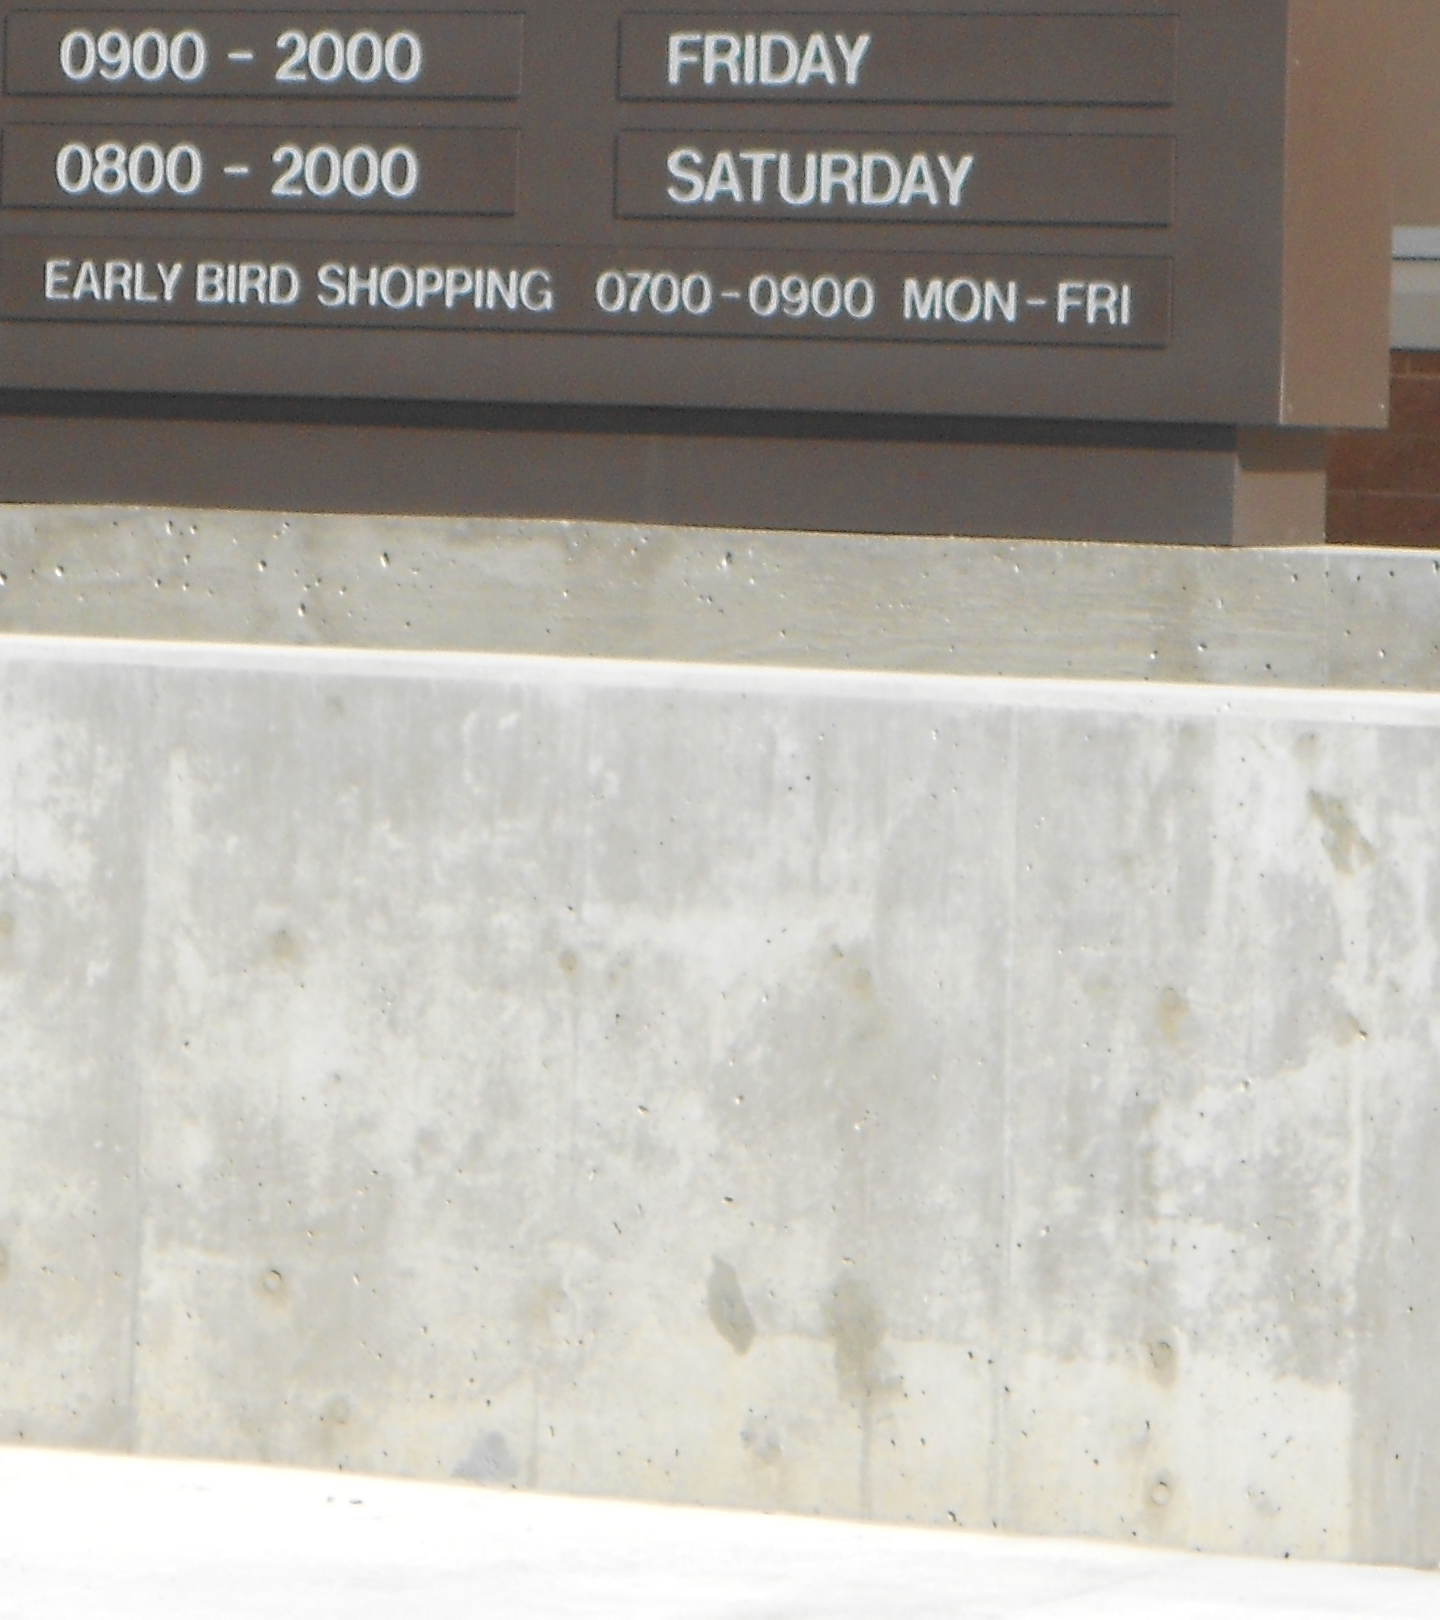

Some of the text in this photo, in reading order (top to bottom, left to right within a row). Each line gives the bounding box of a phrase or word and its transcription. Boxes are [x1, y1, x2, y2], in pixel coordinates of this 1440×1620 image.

[60, 29, 207, 81] 0900
[275, 29, 423, 83] 2000
[668, 31, 871, 86] FRIDAY
[56, 142, 203, 195] 0800
[271, 144, 419, 198] 2000
[666, 147, 974, 207] SATURDAY
[45, 259, 183, 302] EARLY
[196, 262, 300, 305] BIRD
[317, 263, 553, 312] SHOPPING
